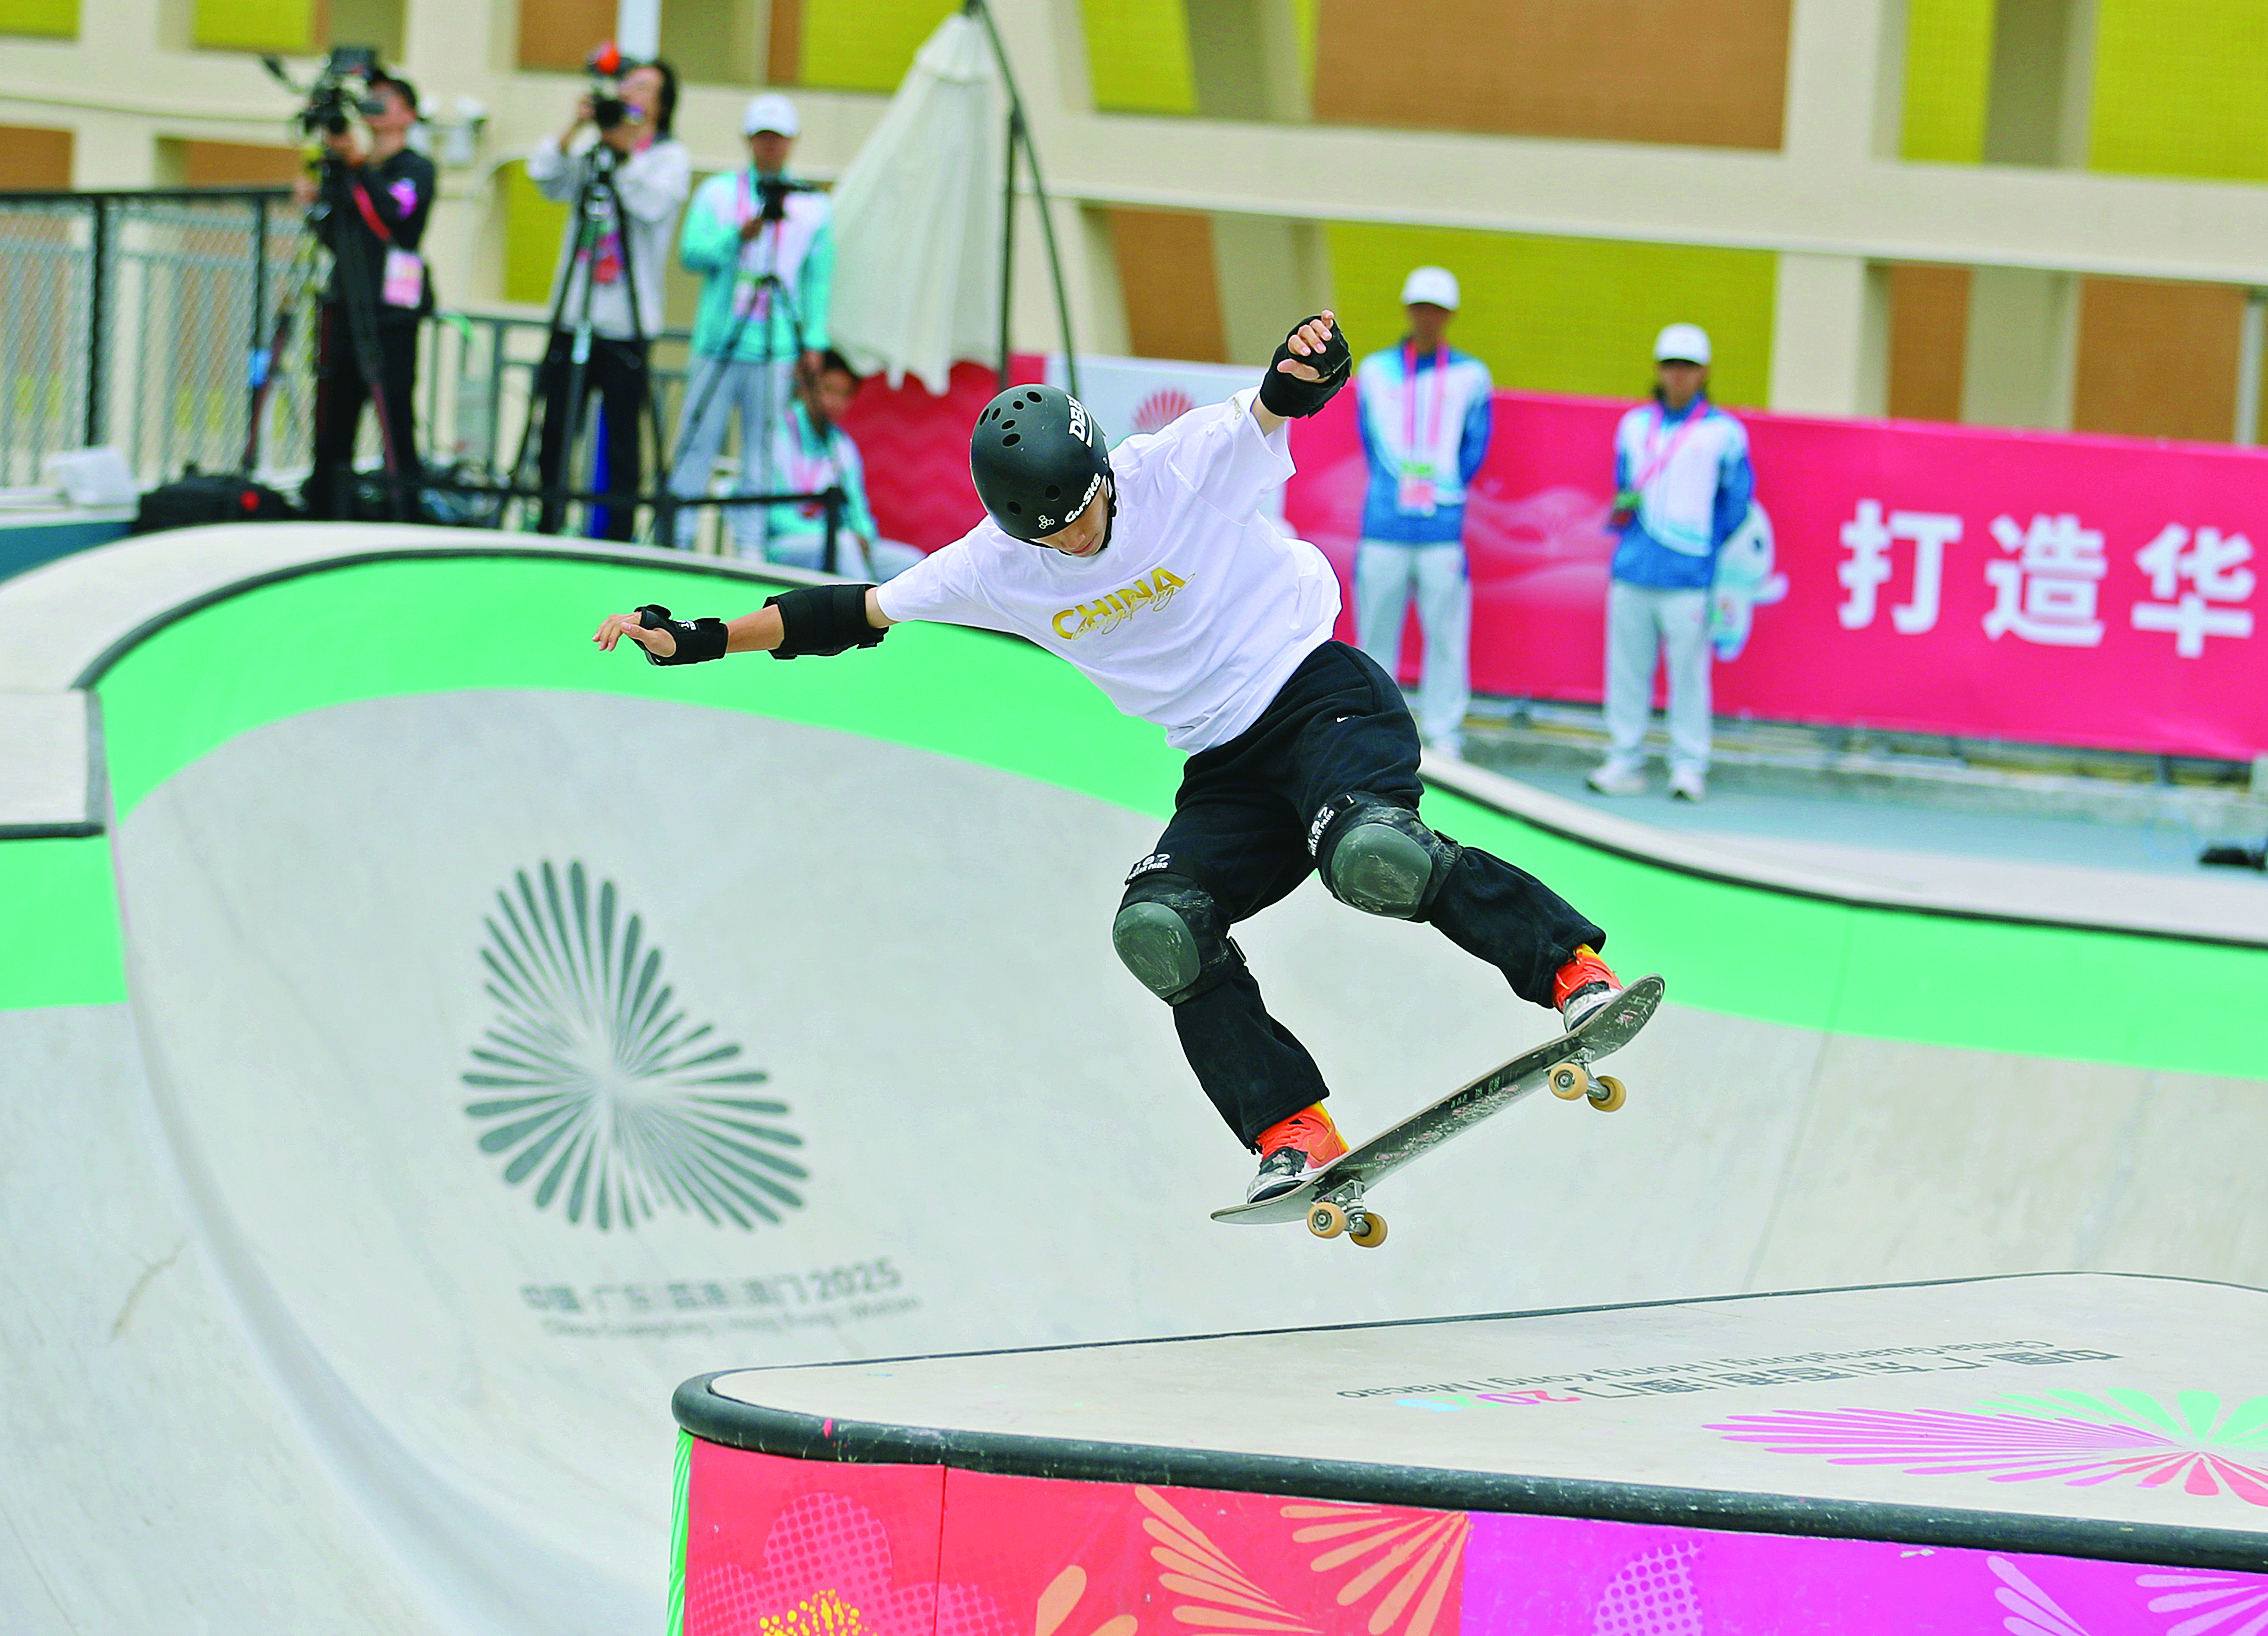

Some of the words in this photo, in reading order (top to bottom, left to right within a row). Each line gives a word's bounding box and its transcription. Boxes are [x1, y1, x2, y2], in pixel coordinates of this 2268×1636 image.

[1837, 499, 2257, 659] 打造华
[1051, 566, 1187, 640] CHINA
[808, 1256, 903, 1303] 2025
[1487, 1372, 1609, 1390] Kong
[1593, 1363, 1715, 1381] Hong
[1336, 1382, 1480, 1399] Macao
[1395, 1389, 1583, 1412] 2025
